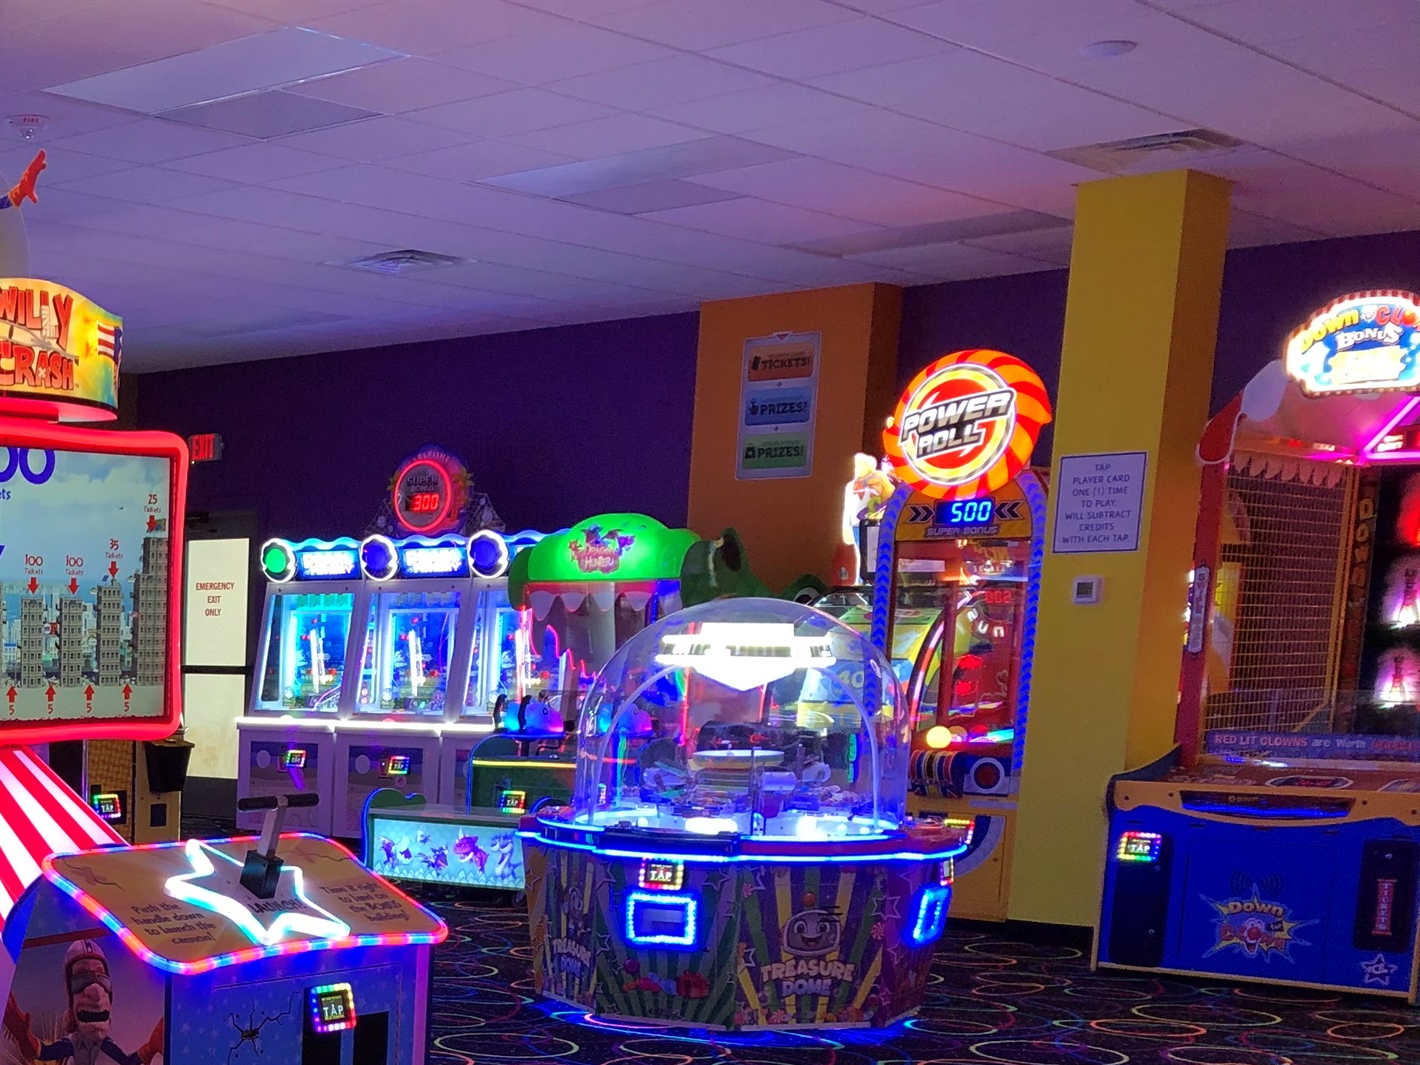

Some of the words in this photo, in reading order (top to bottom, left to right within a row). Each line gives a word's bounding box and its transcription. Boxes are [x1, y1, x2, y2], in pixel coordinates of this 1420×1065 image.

[1335, 323, 1403, 351] BONUS
[761, 357, 810, 370] TICKETS!
[760, 401, 808, 415] PRIZES!
[900, 390, 1014, 443] POWER
[917, 423, 982, 456] ROLL
[191, 434, 215, 460] EXIT
[757, 445, 805, 459] PRIZES!
[1095, 463, 1111, 471] TAP
[1072, 475, 1104, 485] PLAYER
[1106, 474, 1131, 483] CARD
[1072, 488, 1091, 497] ONE
[1108, 486, 1129, 495] TIME
[147, 494, 158, 505] 25
[413, 493, 440, 512] 300
[1081, 500, 1093, 508] TO
[143, 506, 162, 514] Tickets
[951, 501, 992, 522] 500
[1065, 512, 1084, 520] WILL
[1087, 510, 1132, 520] SUBTRACT
[926, 527, 960, 536] SUPER
[962, 525, 998, 535] BONUS
[1079, 522, 1115, 532] CREDITS
[1062, 536, 1084, 544] WITH
[1087, 534, 1110, 543] EACH
[109, 539, 119, 551] 35
[25, 554, 44, 566] 100
[65, 555, 84, 567] 100
[105, 552, 123, 560] Tickets
[65, 568, 84, 576] Tickets
[195, 582, 235, 591] EMERGENCY
[207, 595, 222, 604] EXIT
[205, 608, 222, 617] ONLY
[8, 705, 15, 716] 5
[47, 704, 54, 714] 5
[86, 702, 93, 713] 5
[123, 702, 130, 713] 5
[1214, 735, 1237, 744] RED
[1239, 736, 1257, 745] LIT
[1260, 736, 1308, 747] CLOWNS
[1311, 738, 1331, 747] are
[1336, 738, 1366, 748] Worth
[101, 804, 114, 812] TAP
[1131, 844, 1151, 852] TAP
[650, 869, 672, 880] TAP
[130, 904, 160, 914] Push
[160, 902, 180, 911] the
[1227, 901, 1285, 918] DOWN
[131, 914, 171, 925] handle
[173, 912, 204, 921] down
[144, 928, 160, 936] to
[196, 921, 217, 930] the
[760, 959, 855, 982] TREASURE
[782, 979, 832, 997] DOME
[322, 1004, 344, 1017] TAP
